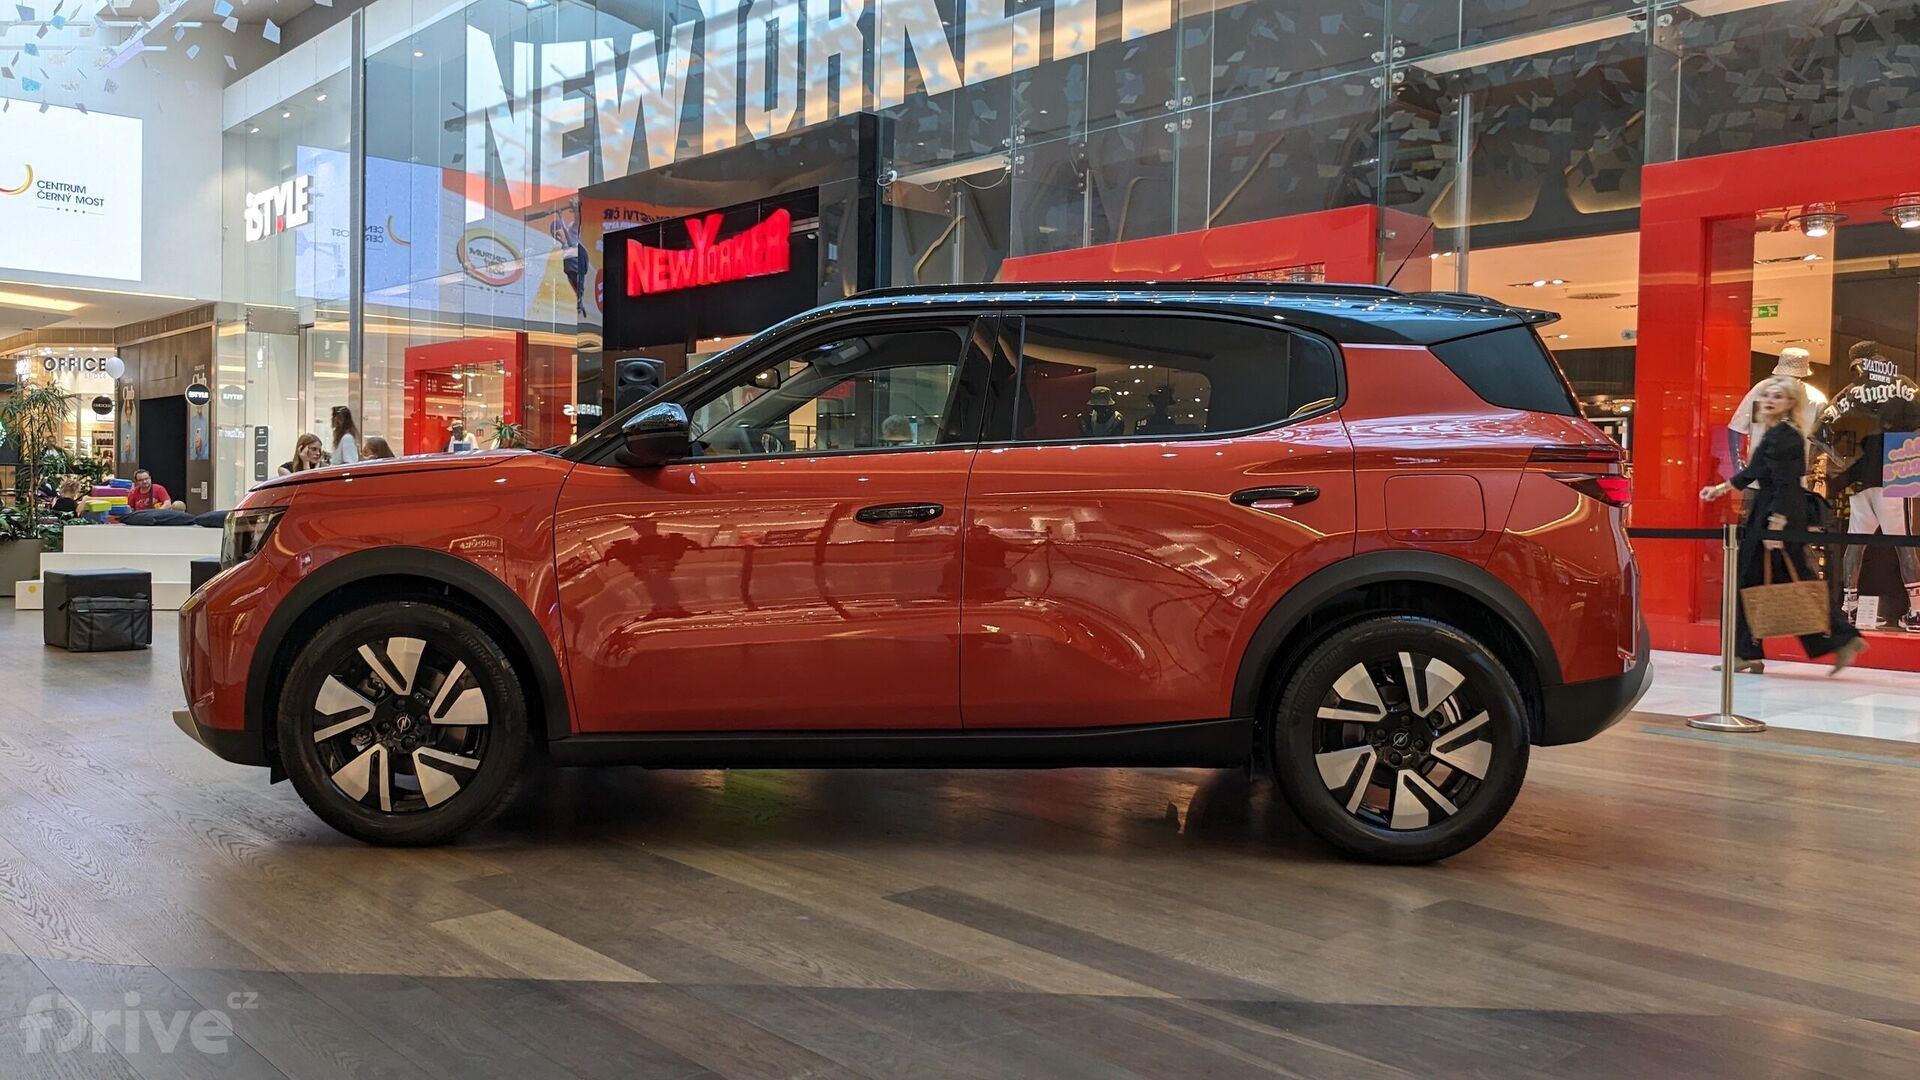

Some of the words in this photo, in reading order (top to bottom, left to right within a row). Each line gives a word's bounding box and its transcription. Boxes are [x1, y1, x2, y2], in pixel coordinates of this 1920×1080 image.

[37, 180, 87, 194] CENTRUM
[37, 189, 72, 203] ČERNÝ
[75, 195, 105, 207] MOST
[244, 174, 309, 242] iSTYLE
[44, 357, 107, 371] OFFICE
[1850, 379, 1919, 404] Angeles
